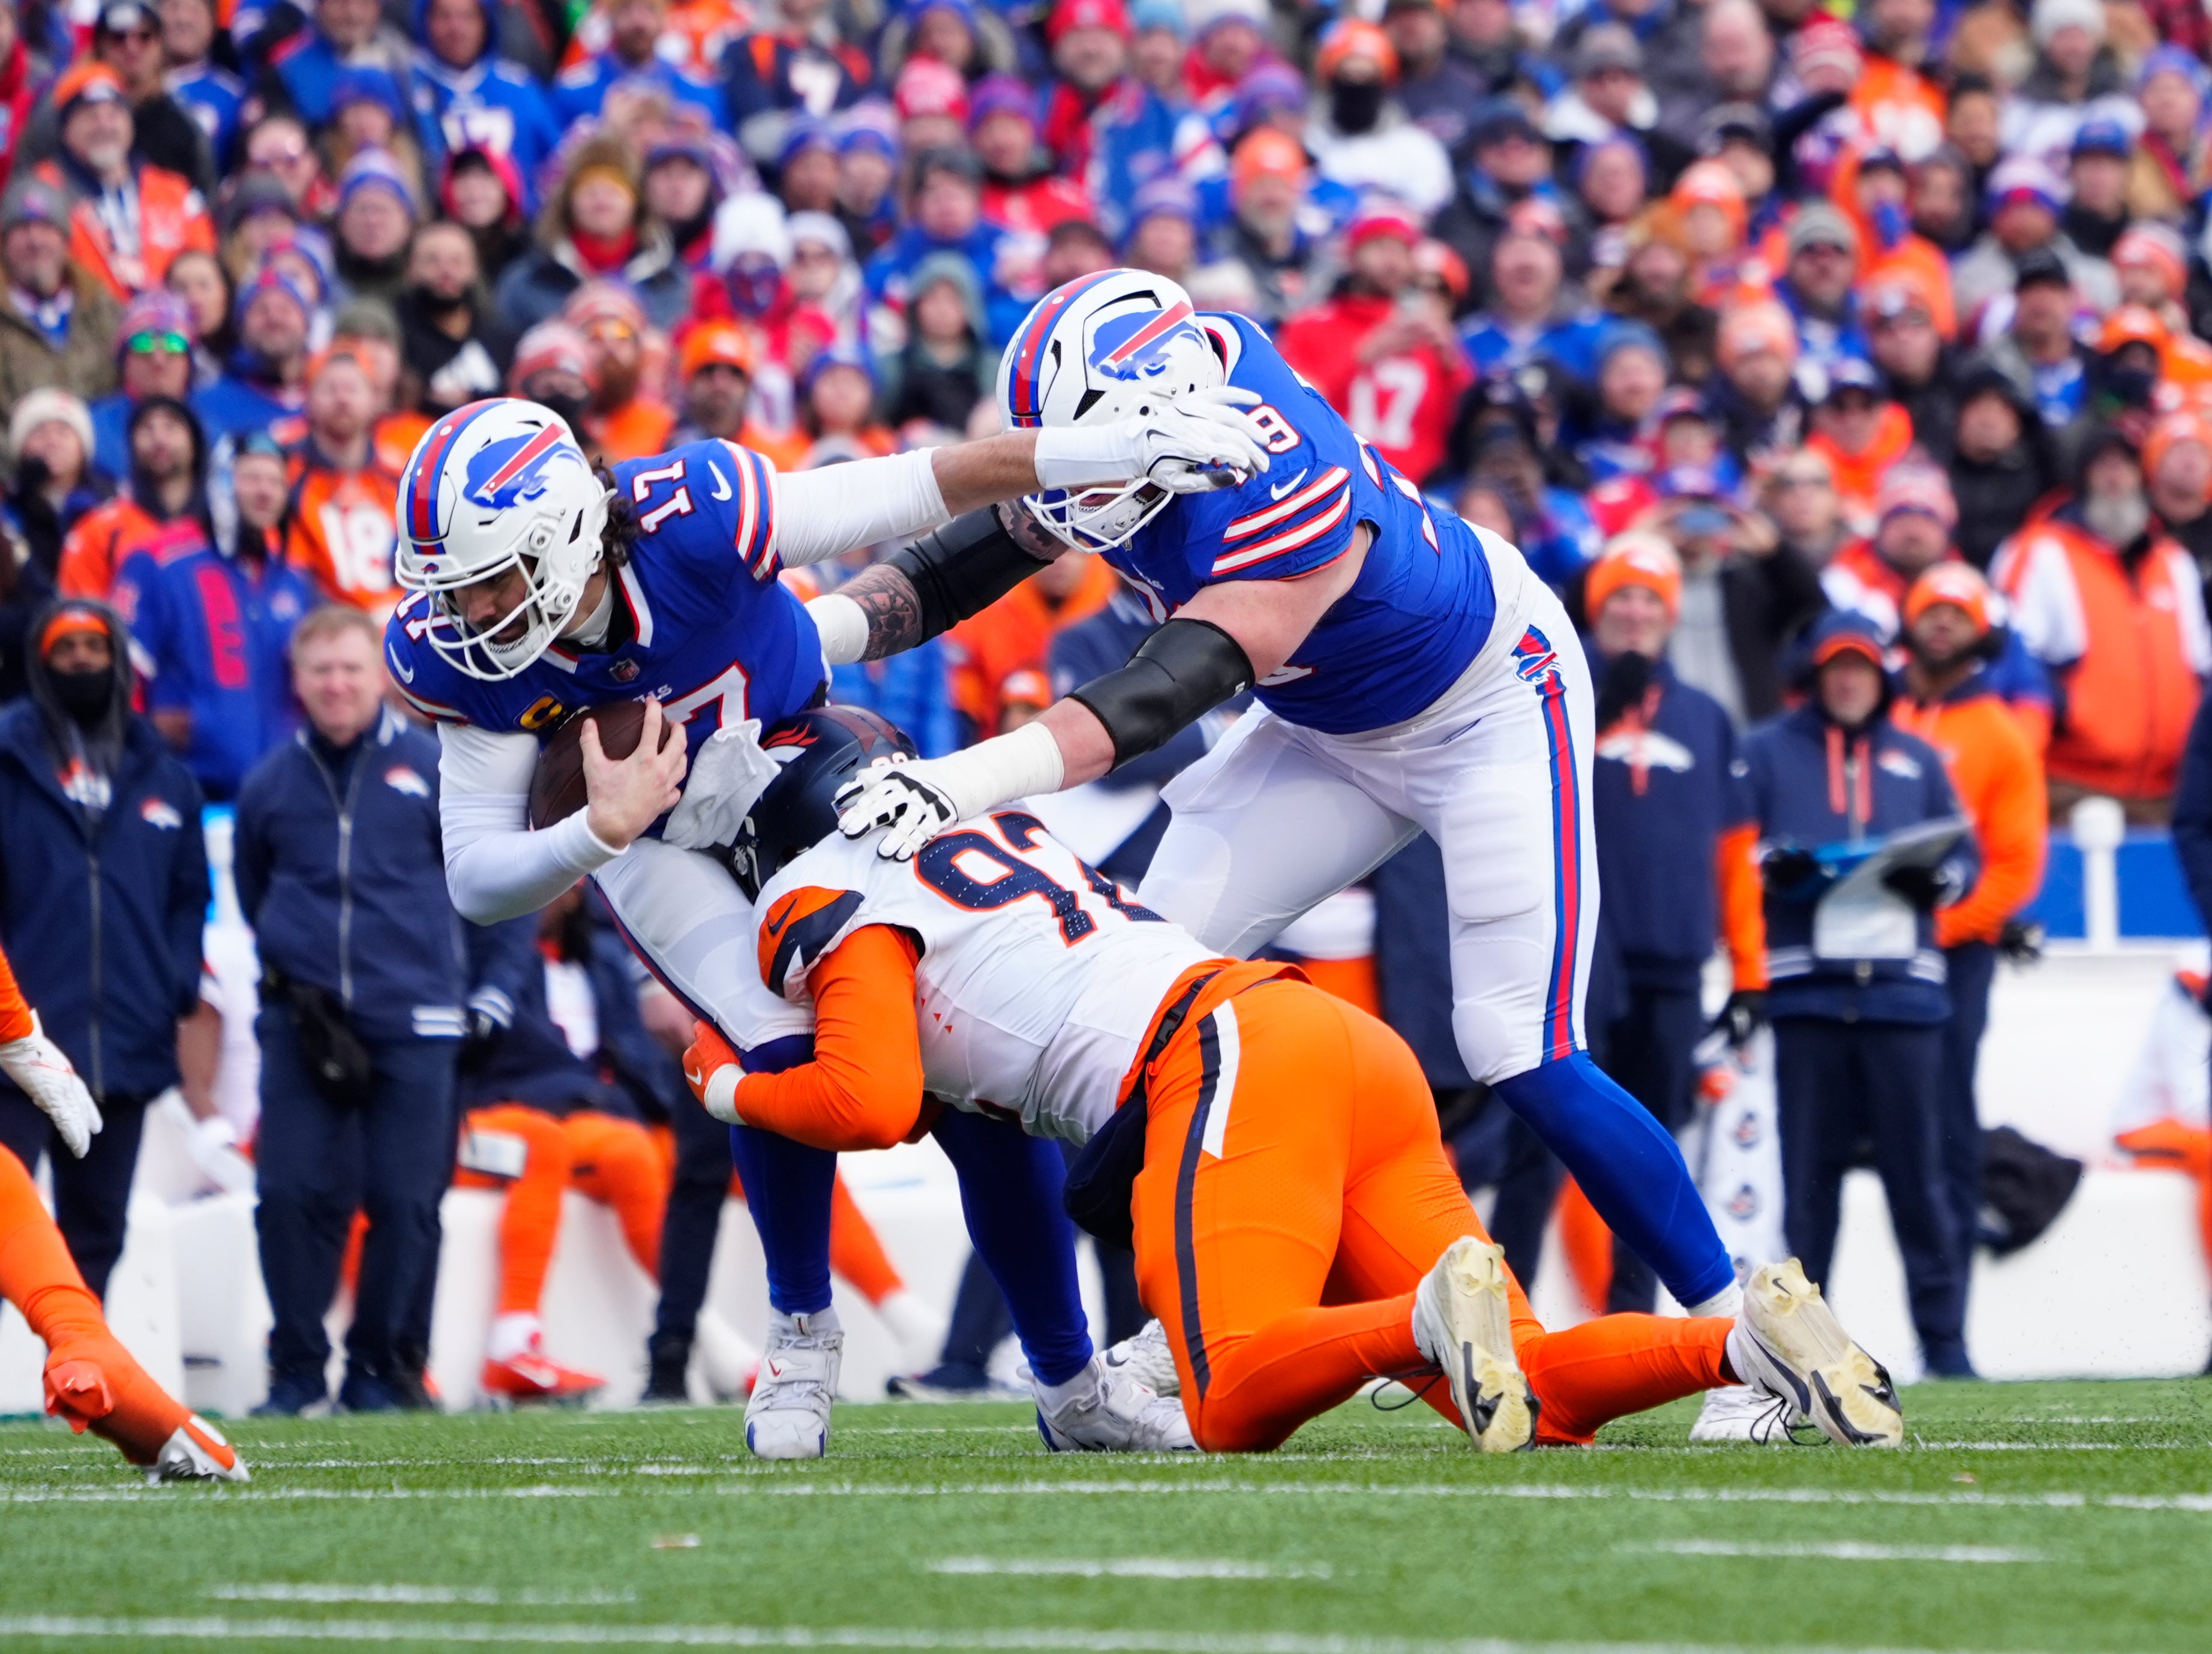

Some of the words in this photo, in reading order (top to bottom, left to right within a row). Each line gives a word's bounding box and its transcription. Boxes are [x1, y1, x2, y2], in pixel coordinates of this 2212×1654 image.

[1348, 359, 1426, 449] 17
[631, 458, 695, 535] 17
[520, 696, 563, 730] C
